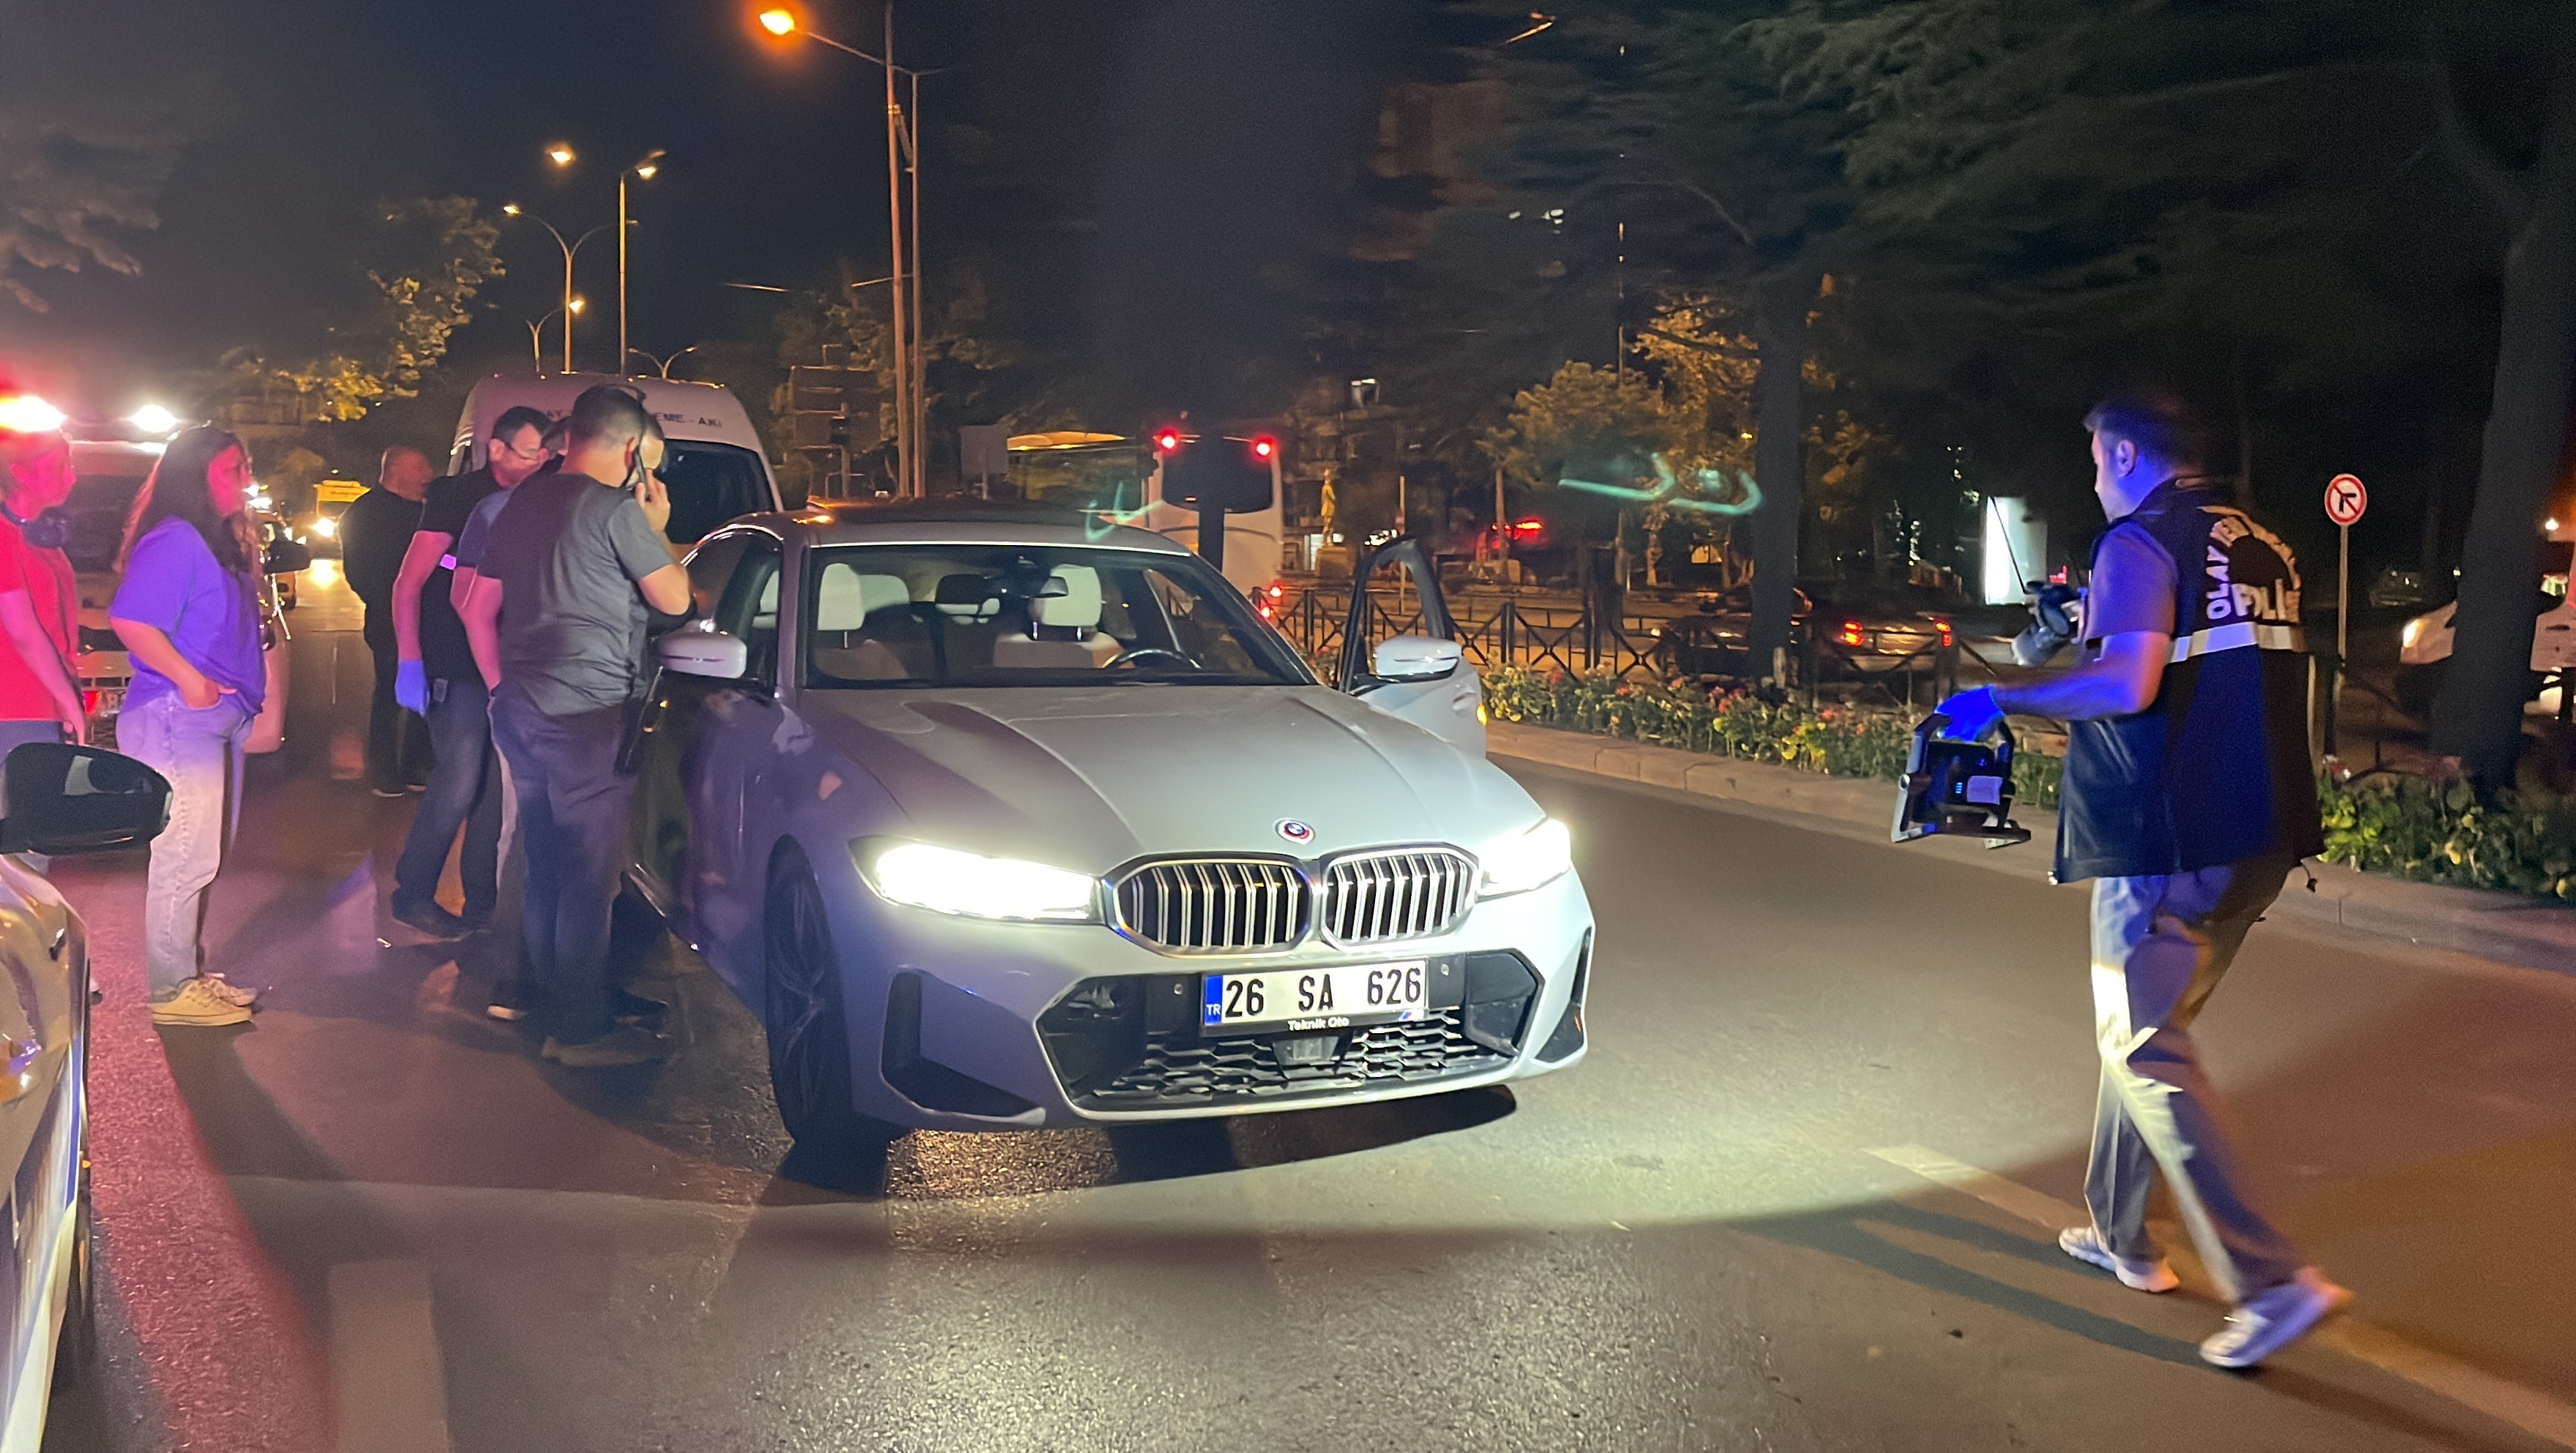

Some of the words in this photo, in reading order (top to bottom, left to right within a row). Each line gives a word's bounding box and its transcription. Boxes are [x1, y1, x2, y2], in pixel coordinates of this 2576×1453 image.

[1225, 978, 1264, 1018] 26
[1298, 973, 1334, 1013] SA
[1367, 967, 1422, 1007] 626
[1205, 1003, 1221, 1016] TR
[1287, 1018, 1327, 1032] Teknik
[1328, 1015, 1350, 1028] Oto
